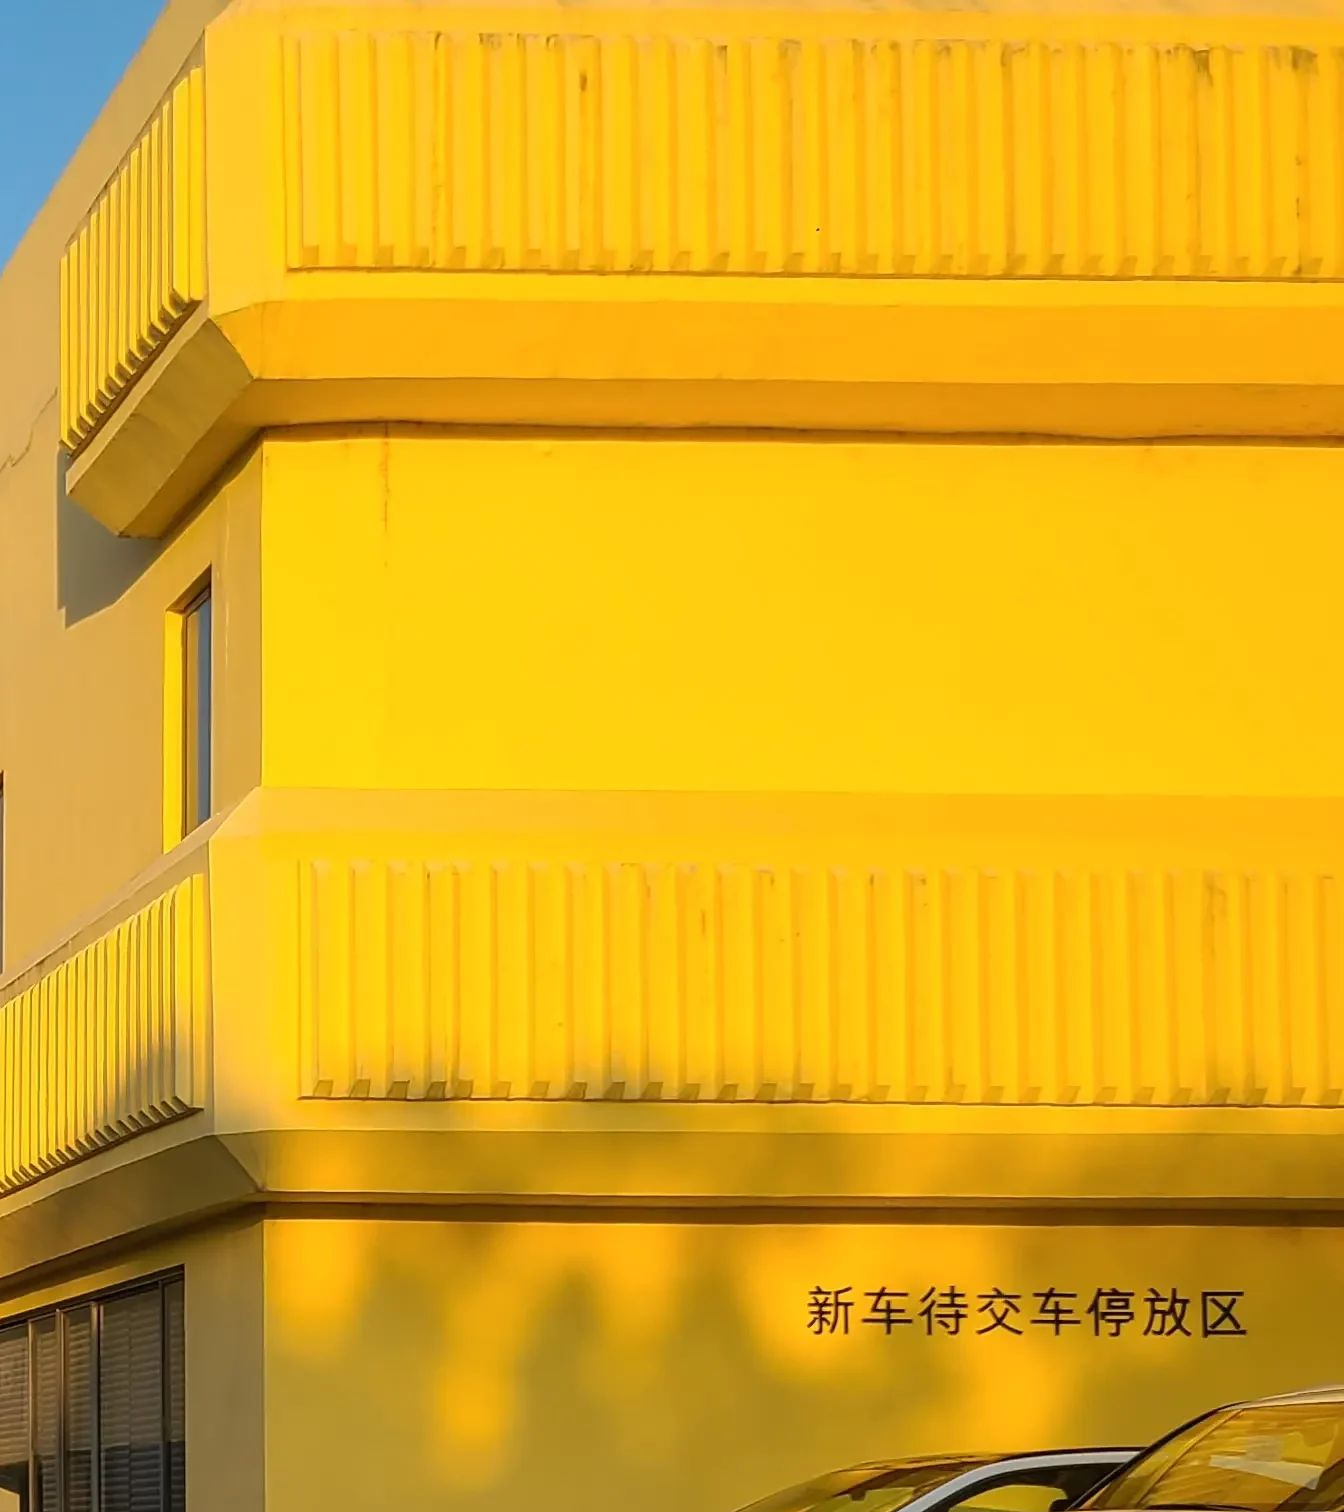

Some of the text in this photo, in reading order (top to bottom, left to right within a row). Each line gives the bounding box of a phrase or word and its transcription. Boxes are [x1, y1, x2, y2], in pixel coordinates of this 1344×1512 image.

[807, 1285, 1249, 1339] 新车待交车停放区
